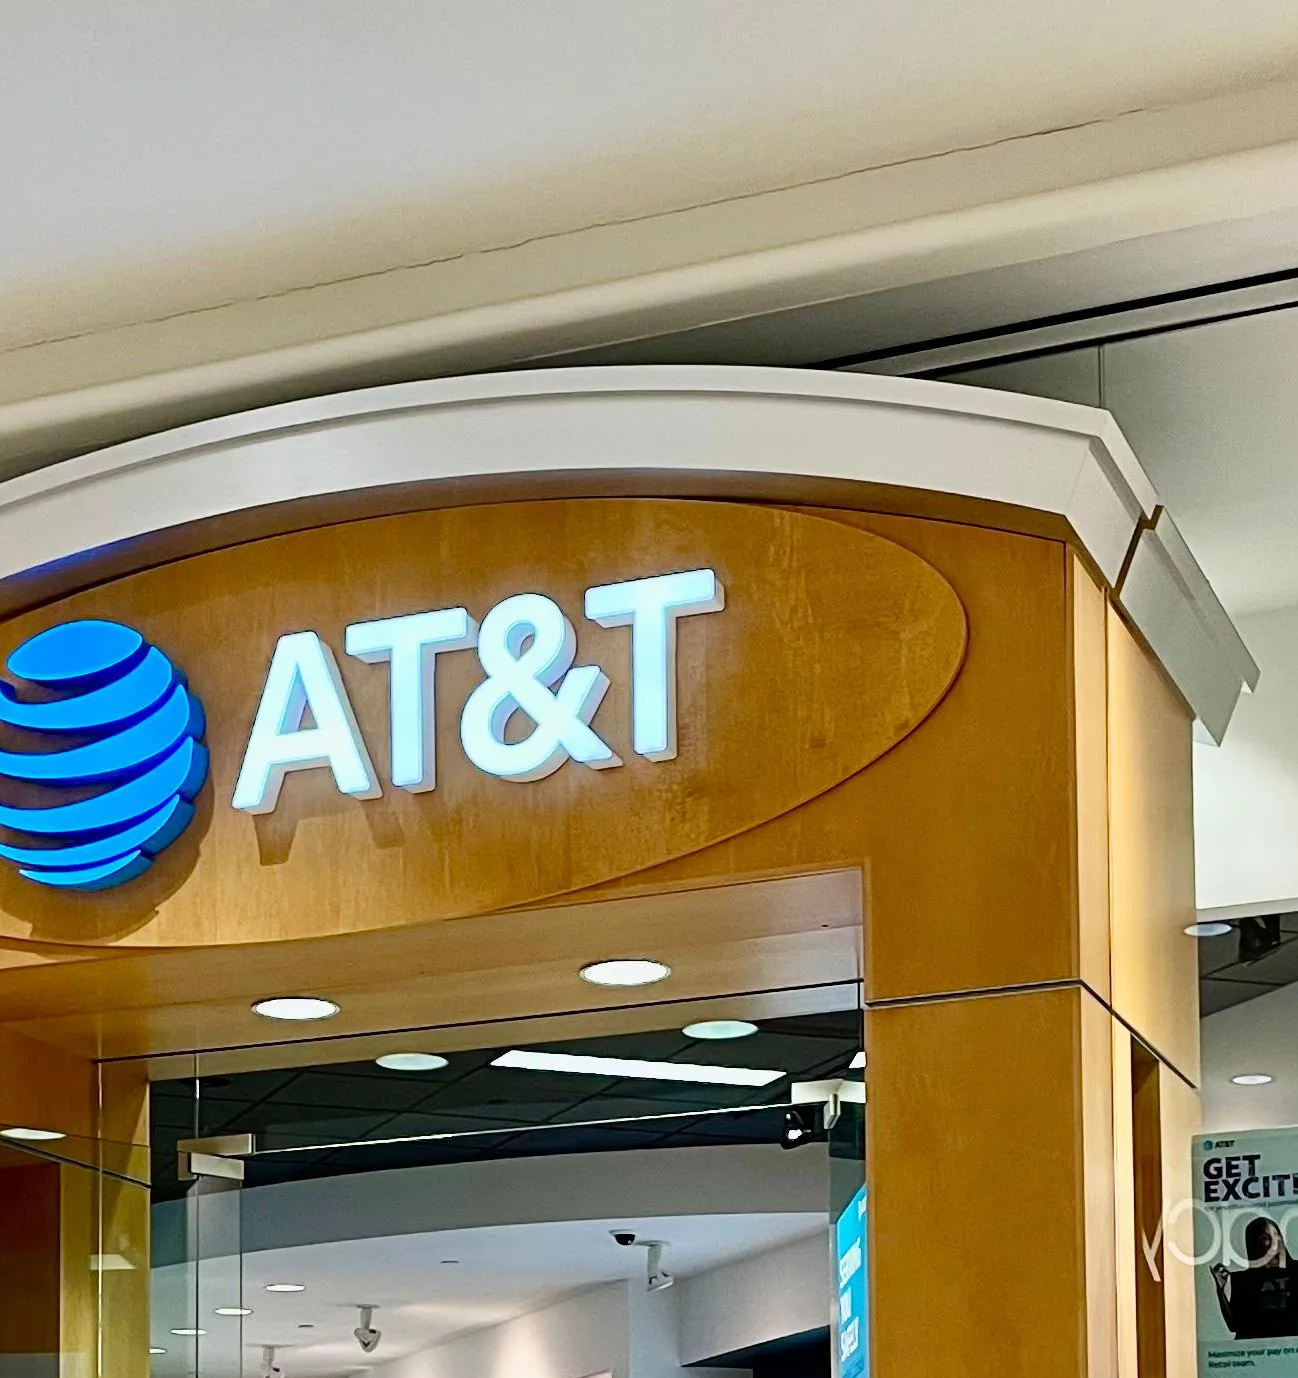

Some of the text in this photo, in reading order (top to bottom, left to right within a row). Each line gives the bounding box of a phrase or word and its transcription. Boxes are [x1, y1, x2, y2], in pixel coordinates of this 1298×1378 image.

[232, 568, 724, 814] AT&T
[1203, 1154, 1261, 1179] GET
[1247, 1349, 1265, 1357] your
[1267, 1348, 1282, 1356] pay
